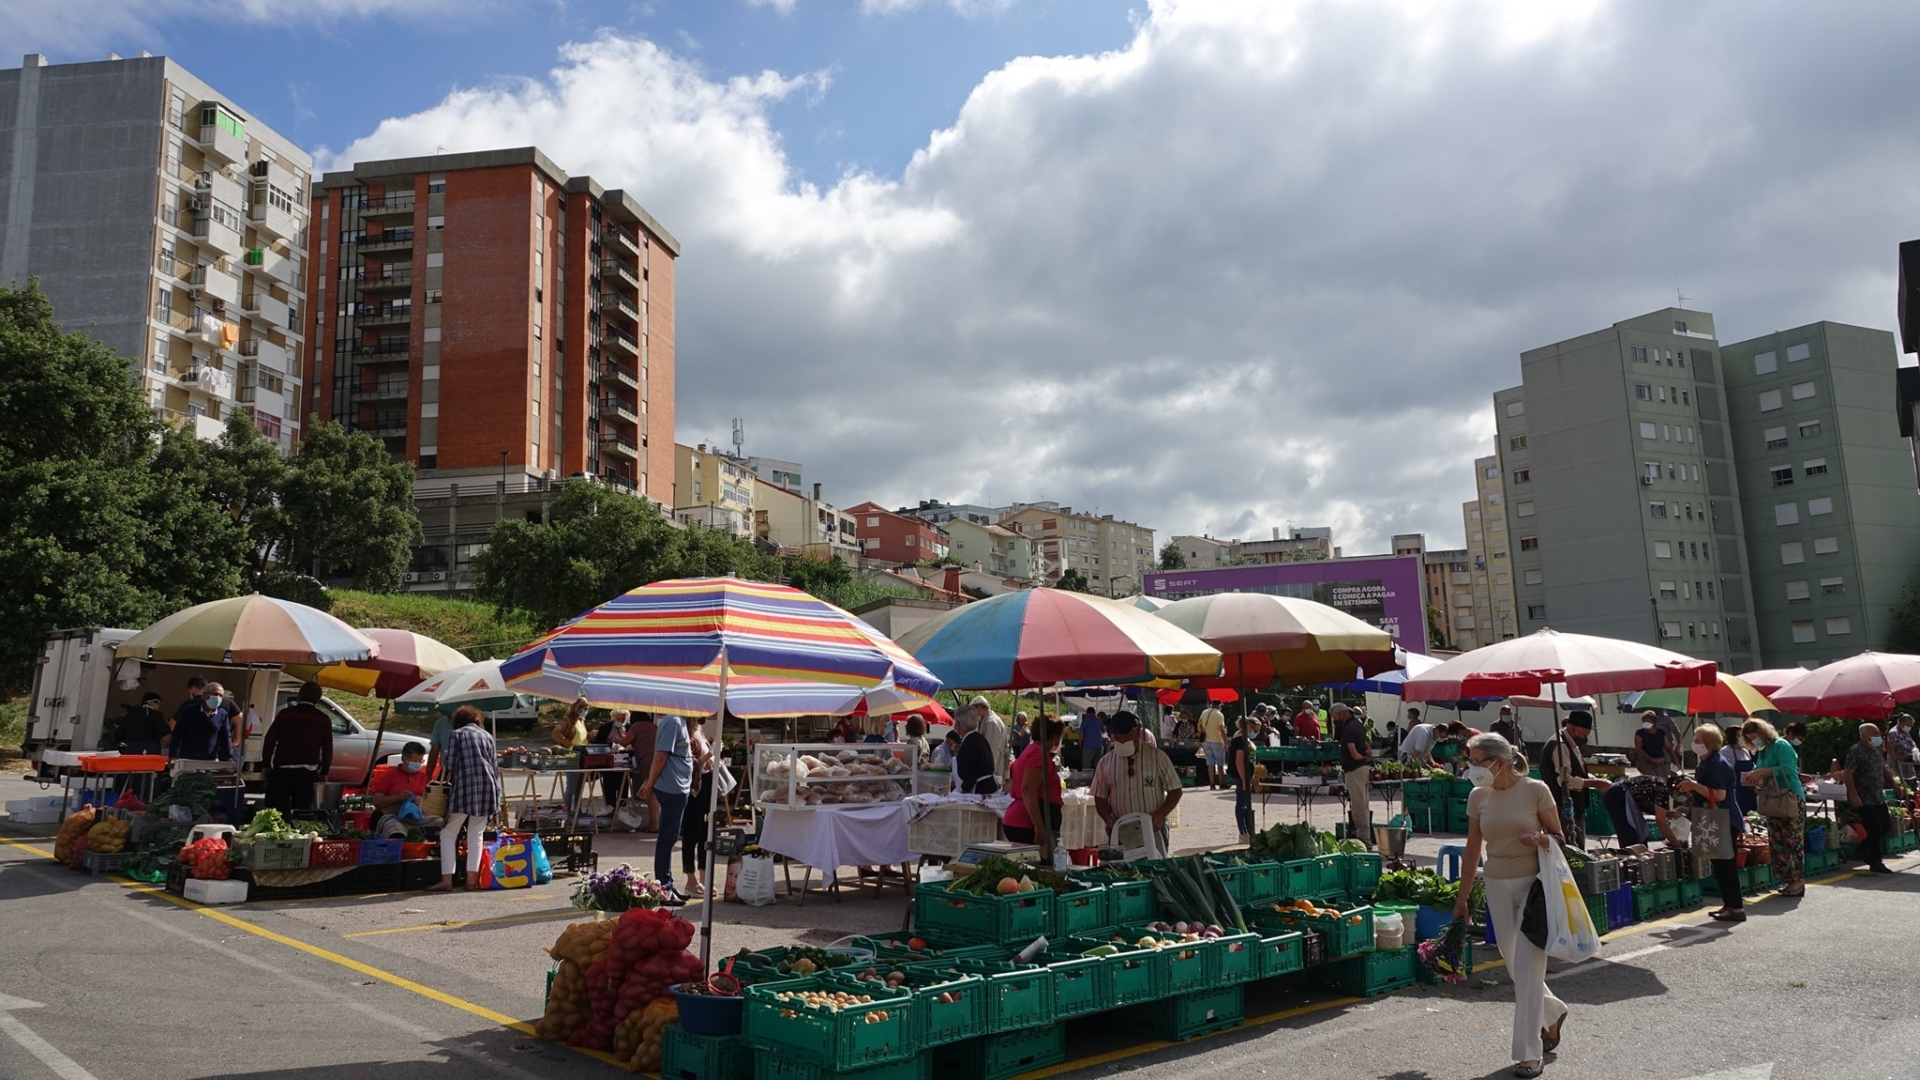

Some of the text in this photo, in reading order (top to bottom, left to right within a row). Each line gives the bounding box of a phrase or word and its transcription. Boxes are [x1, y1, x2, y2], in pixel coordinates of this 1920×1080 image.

[1168, 579, 1198, 587] SEAT
[1332, 586, 1361, 594] COMPRA
[1337, 592, 1366, 600] COMEÇA
[1379, 617, 1399, 625] SEAT
